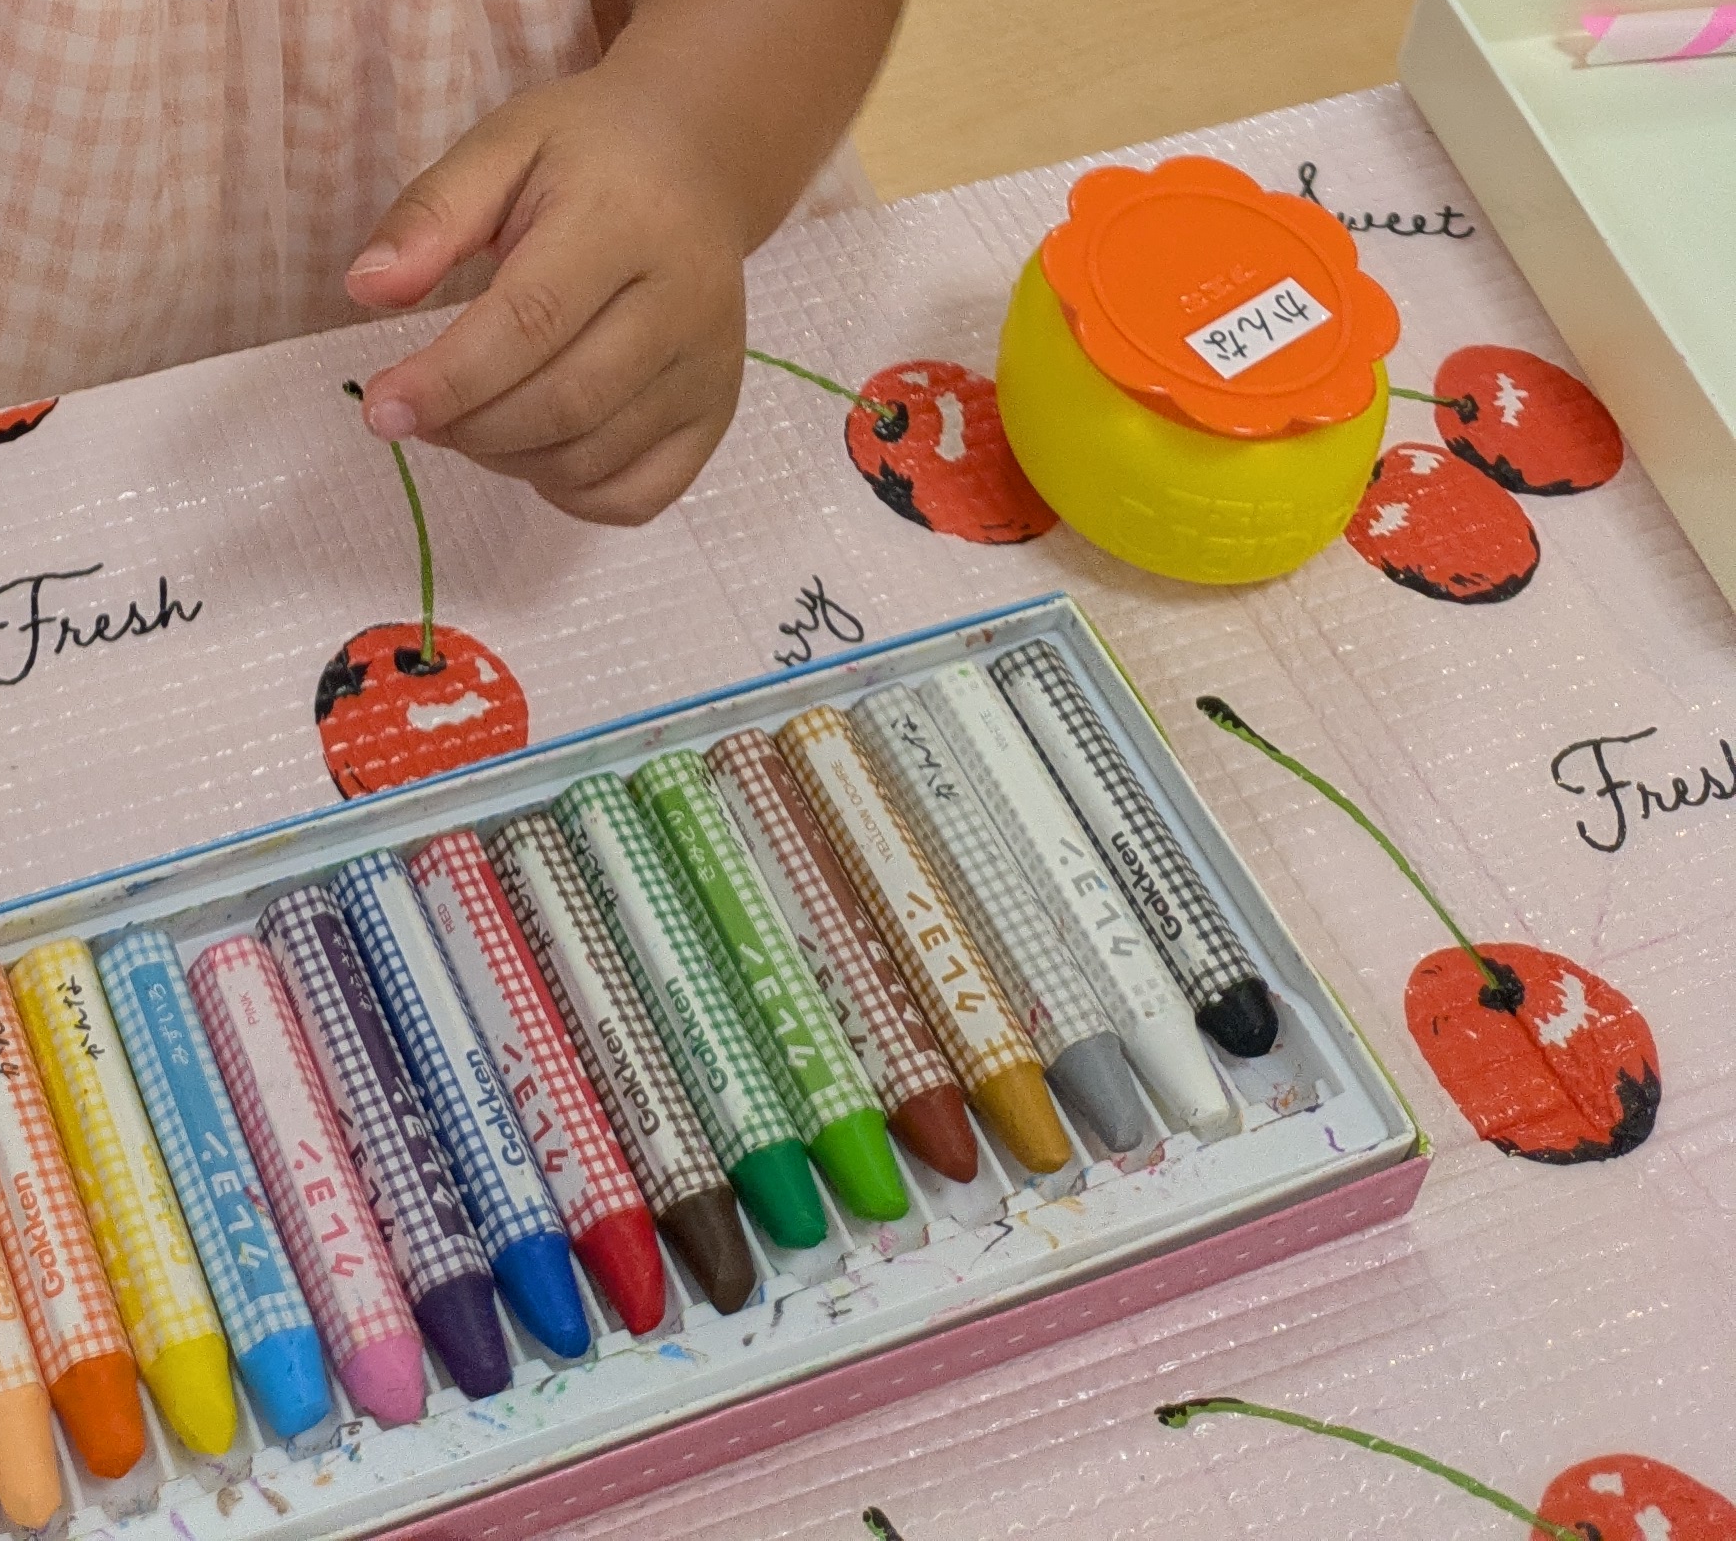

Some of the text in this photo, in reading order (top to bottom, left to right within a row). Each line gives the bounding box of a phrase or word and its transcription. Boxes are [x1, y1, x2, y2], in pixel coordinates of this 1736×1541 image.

[1202, 288, 1309, 364] かんな
[828, 758, 864, 808] OCHRE
[889, 710, 960, 808] かんな
[855, 806, 895, 864] YELLOW
[976, 706, 1145, 964] クレヨン WHITE
[1106, 827, 1186, 943] Gakken
[663, 804, 821, 1073] クレヨン きみどり
[894, 883, 990, 1021] クレヨン
[56, 974, 105, 1063] かんな
[434, 901, 574, 1177] クレヨン RED
[590, 1015, 663, 1138] Gakken
[659, 974, 733, 1095] Gakken
[143, 980, 272, 1273] クレヨン みずいろ
[237, 989, 367, 1283] クレヨン PINK
[385, 1072, 458, 1213] クレヨン
[458, 1045, 529, 1170] Gakken
[6, 1169, 68, 1300] Gakken
